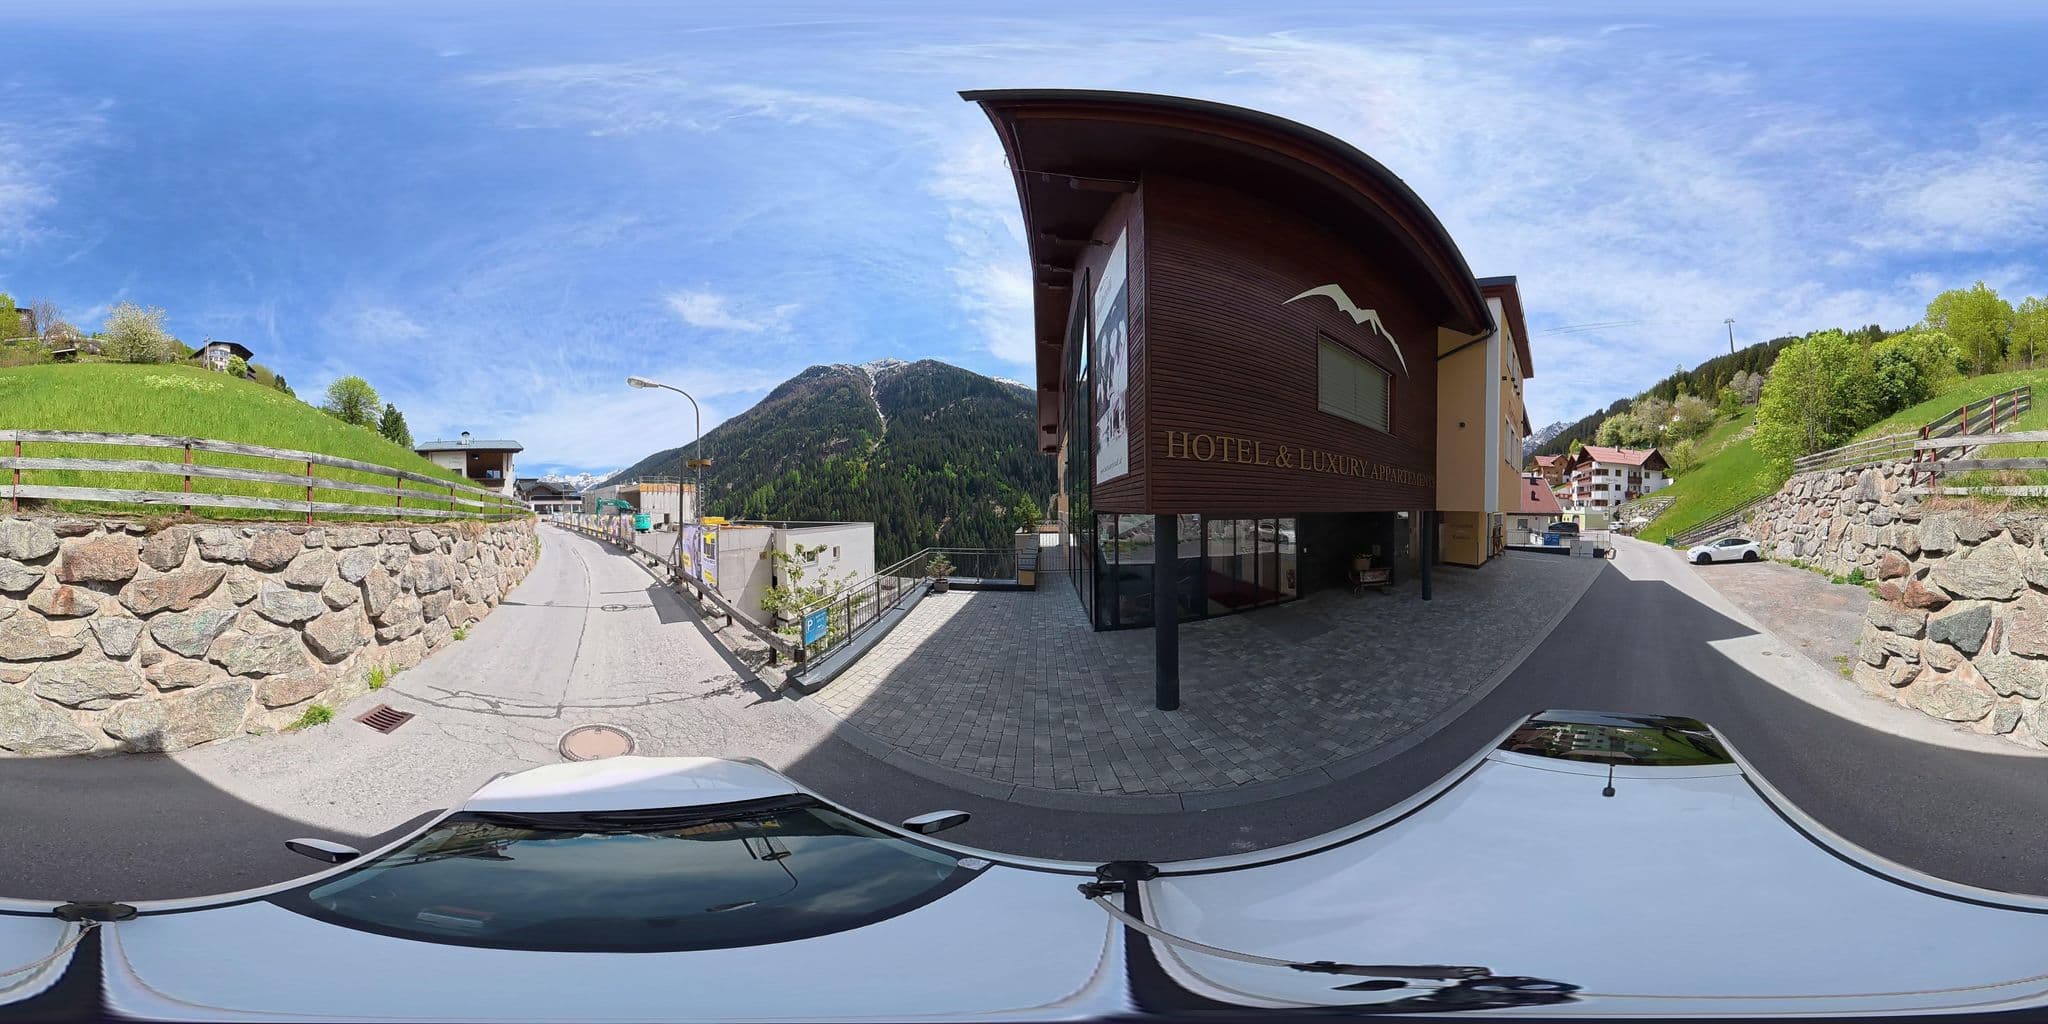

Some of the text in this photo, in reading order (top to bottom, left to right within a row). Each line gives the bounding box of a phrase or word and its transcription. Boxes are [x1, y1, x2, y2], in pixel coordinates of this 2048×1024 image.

[1165, 430, 1270, 465] HOTEL
[1275, 444, 1294, 469] &
[1299, 447, 1369, 478] LUXURY
[807, 619, 813, 631] P
